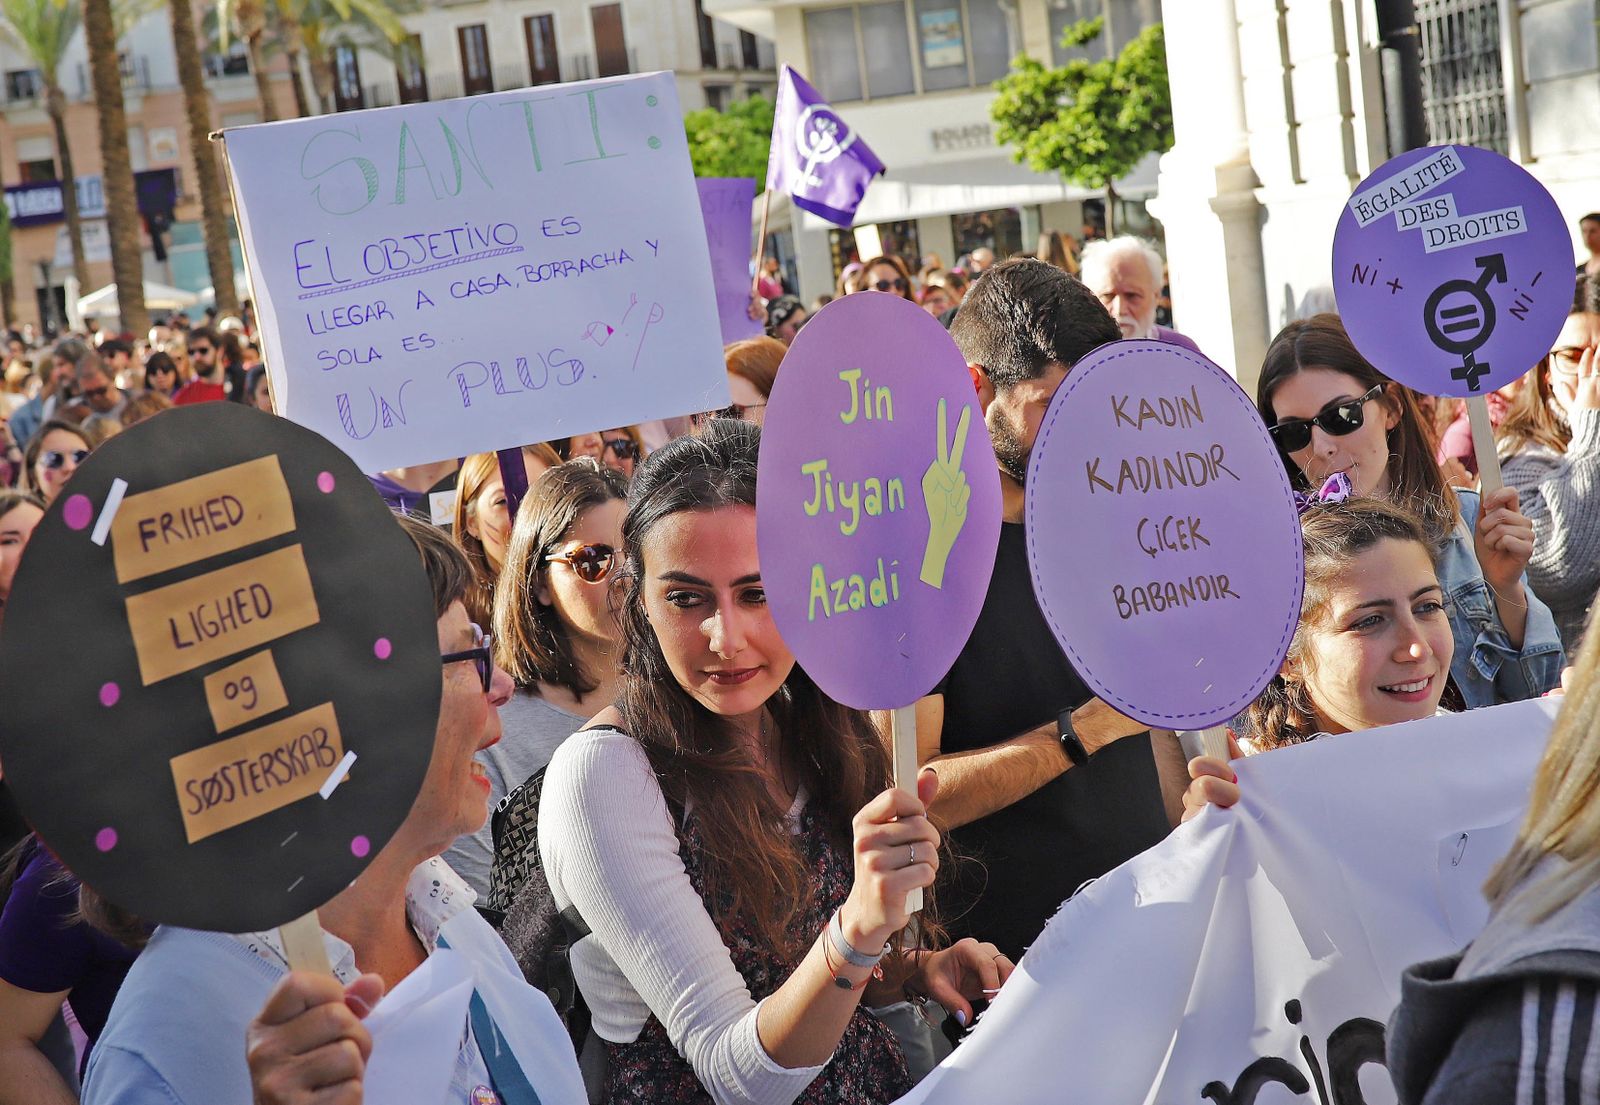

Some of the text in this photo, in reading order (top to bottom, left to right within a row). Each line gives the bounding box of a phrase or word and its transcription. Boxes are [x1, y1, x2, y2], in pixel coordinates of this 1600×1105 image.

[301, 84, 662, 216] SANTI:
[1354, 153, 1457, 223] ÉGALITÉ
[1398, 198, 1450, 228] DES
[294, 239, 352, 289] EL
[540, 216, 582, 237] ES
[1427, 210, 1520, 247] DROITS
[306, 300, 394, 335] LLEGAR
[416, 290, 435, 310] A
[645, 239, 659, 257] Y
[317, 346, 382, 371] SOLA
[336, 348, 598, 440] UN PLUS.
[838, 367, 894, 425] Jin
[1111, 384, 1204, 431] KADIN
[801, 458, 905, 536] Jiyan
[1086, 443, 1240, 494] KADINDIR
[138, 495, 244, 552] FRIHED
[169, 583, 273, 650] LIGHED
[1113, 574, 1241, 620] BABANDIR
[223, 675, 258, 711] og
[185, 727, 336, 816] SØSTERSKAB
